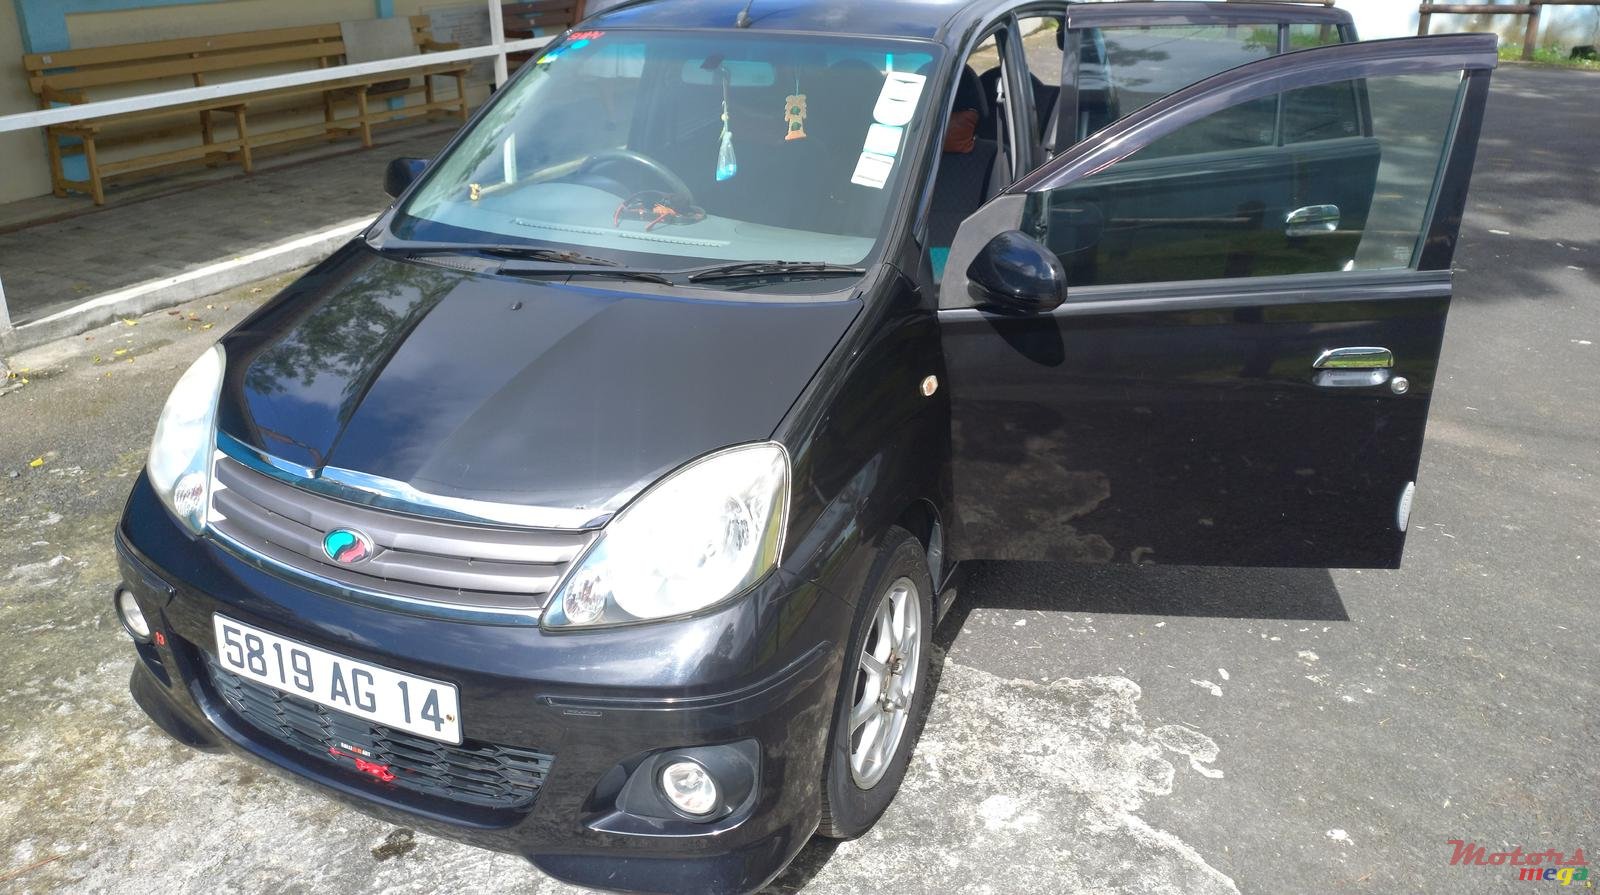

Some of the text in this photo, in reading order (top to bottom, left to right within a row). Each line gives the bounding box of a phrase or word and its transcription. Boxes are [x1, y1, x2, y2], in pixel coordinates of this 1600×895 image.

[223, 624, 445, 732] 5819 AG 14
